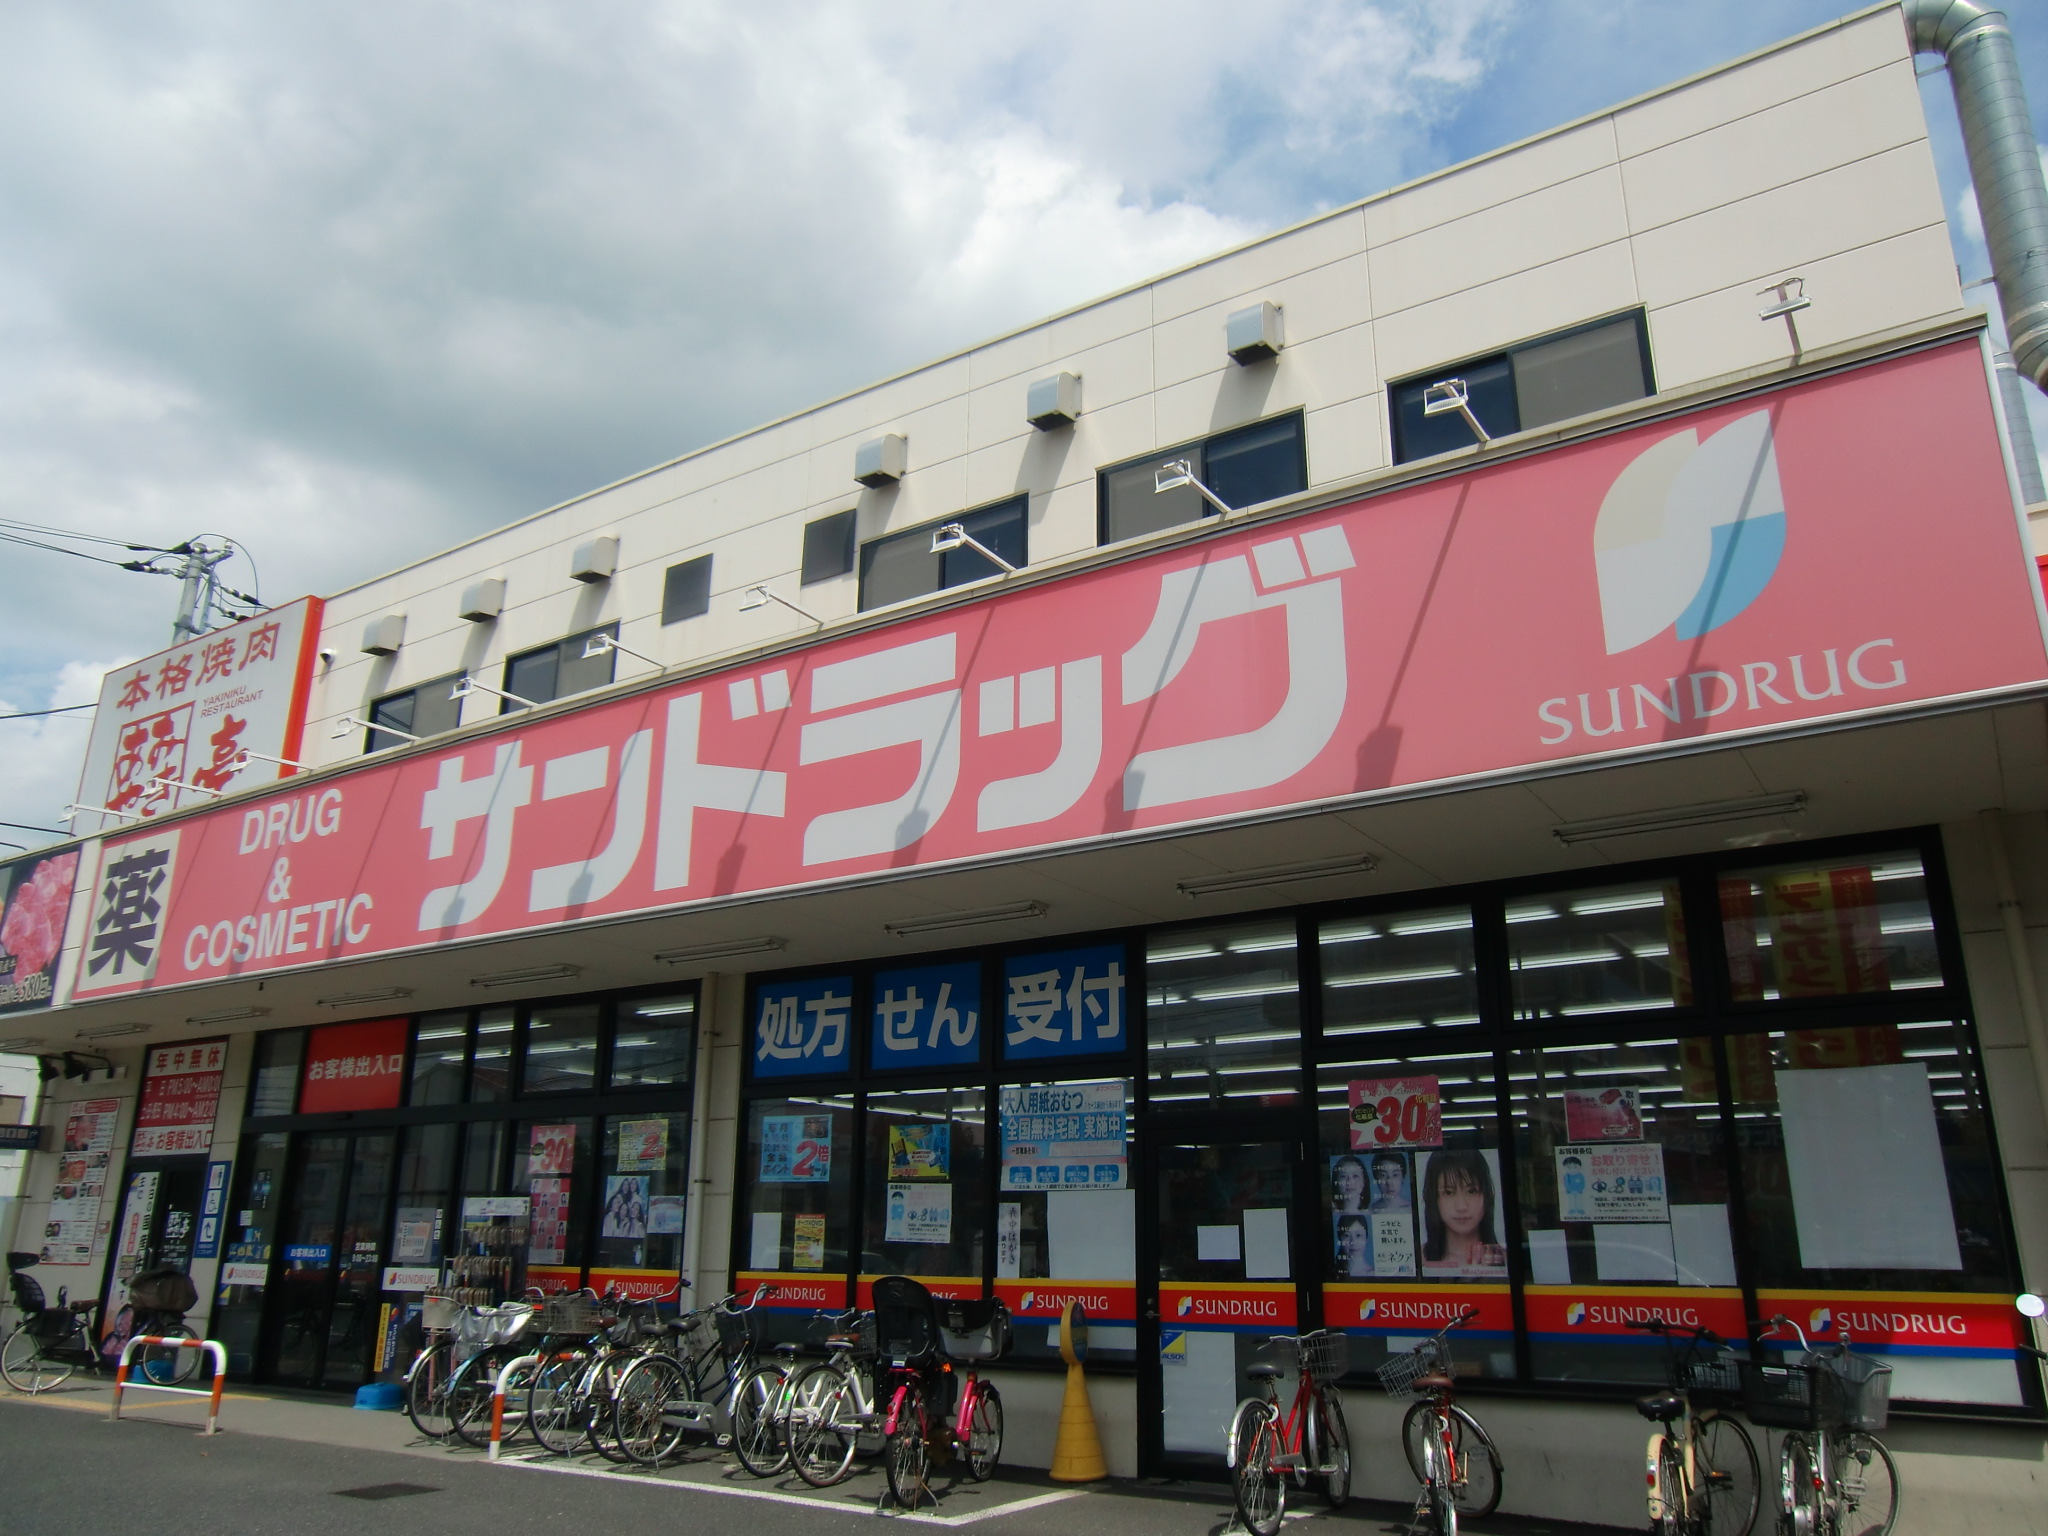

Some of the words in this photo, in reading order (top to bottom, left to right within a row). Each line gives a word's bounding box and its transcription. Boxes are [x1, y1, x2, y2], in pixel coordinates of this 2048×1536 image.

[116, 622, 281, 712] 本格焼肉
[201, 690, 264, 718] RESTAURANT
[203, 686, 246, 707] YAKINIKU
[1538, 638, 1907, 745] SUNDRUG
[418, 525, 1356, 931] サンドラッグ
[239, 788, 342, 855] DRUG
[267, 857, 292, 903] &
[88, 848, 170, 977] 薬
[184, 893, 373, 971] COSMETIC
[757, 990, 852, 1061] 処方
[1006, 962, 1125, 1046] 受付
[156, 1046, 221, 1073] 年中無休
[309, 1054, 404, 1081] お客様出入口
[1004, 1090, 1083, 1114] 大人用紙おむつ
[1006, 1114, 1080, 1141] 全国無料宅配
[1083, 1112, 1121, 1139] 実施中
[156, 1130, 213, 1151] お客様出入口
[290, 1248, 327, 1258] お客様出入口
[233, 1268, 266, 1280] SUNDRUG
[396, 1273, 436, 1285] SUNDRUG
[615, 1281, 664, 1295] SUNDRUG
[1195, 1299, 1277, 1316] SUNDRUG
[1590, 1305, 1698, 1326] SUNDRUG
[1837, 1310, 1967, 1335] SUNDRUG
